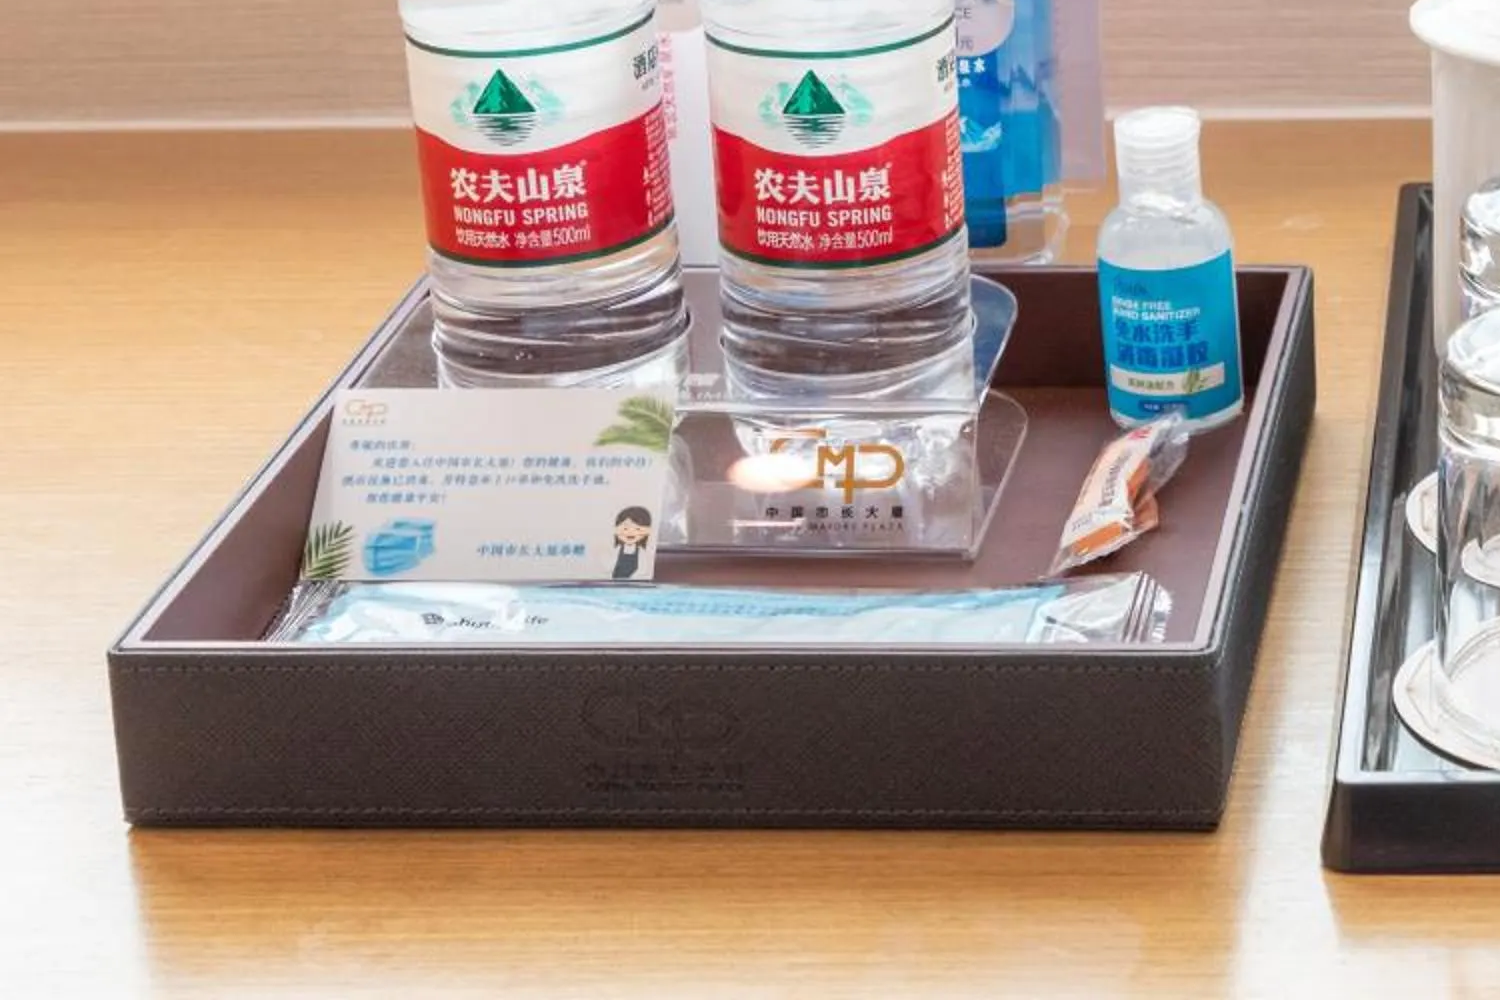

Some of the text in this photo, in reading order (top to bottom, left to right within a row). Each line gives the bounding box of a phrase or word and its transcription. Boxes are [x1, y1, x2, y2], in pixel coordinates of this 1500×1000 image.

[450, 162, 588, 204] 农夫山泉
[753, 165, 892, 205] 农夫山泉
[453, 201, 589, 227] NONGFU SPRING
[756, 204, 893, 228] NONGFU SPRING
